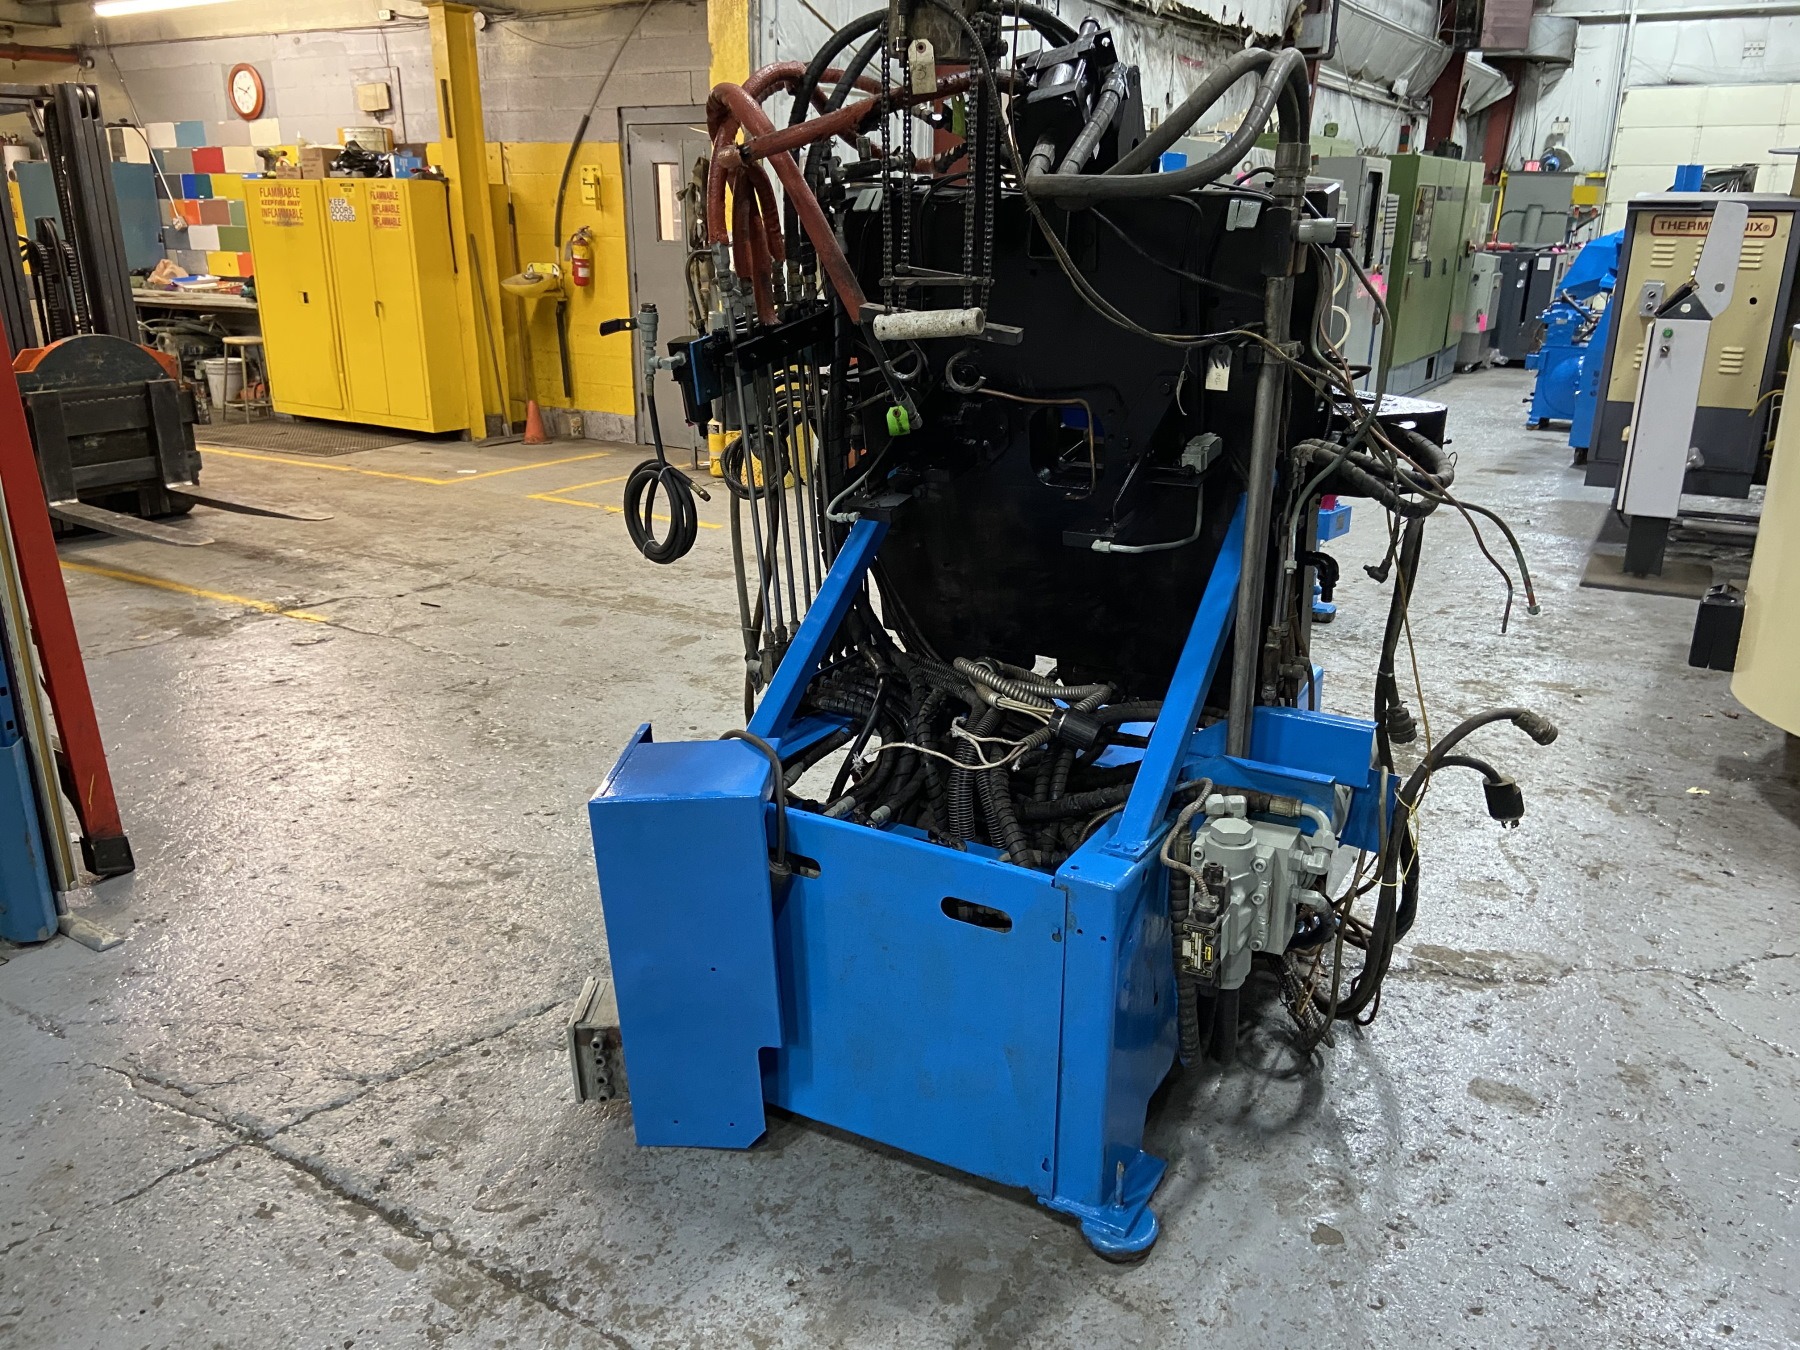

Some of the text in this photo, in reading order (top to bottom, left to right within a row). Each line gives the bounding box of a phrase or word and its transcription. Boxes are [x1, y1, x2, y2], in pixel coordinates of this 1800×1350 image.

[260, 187, 300, 198] FLAMMABLE
[370, 190, 399, 200] FLAMMABLE
[329, 198, 346, 206] KEEP
[261, 208, 304, 219] INFLAMMABLE
[330, 206, 354, 214] DOORS
[331, 214, 356, 222] CLOSED
